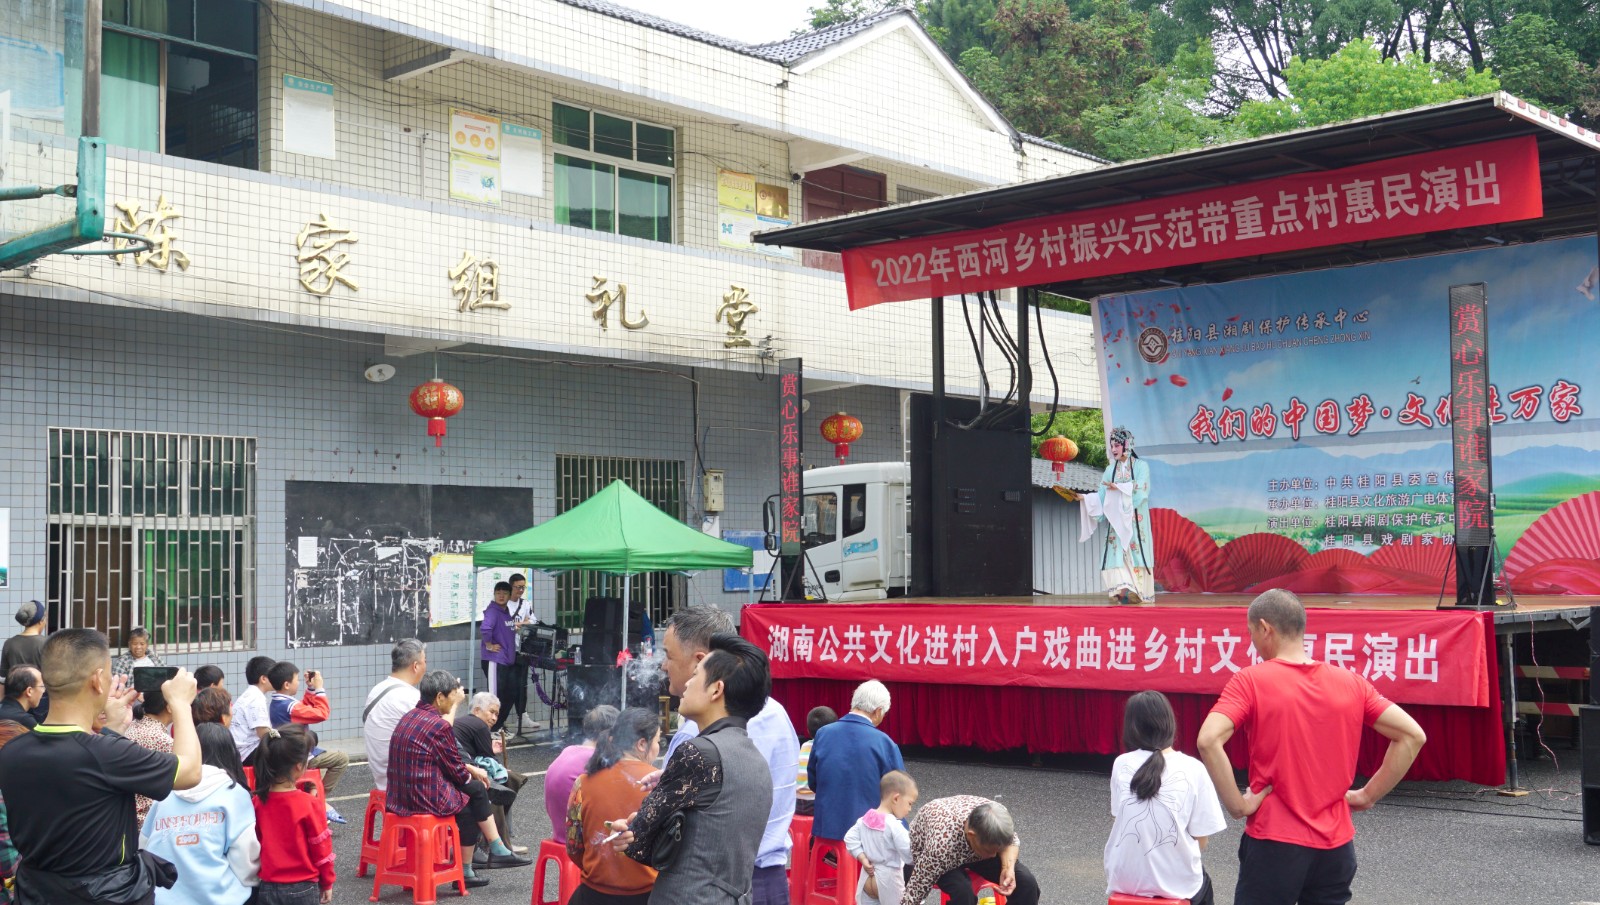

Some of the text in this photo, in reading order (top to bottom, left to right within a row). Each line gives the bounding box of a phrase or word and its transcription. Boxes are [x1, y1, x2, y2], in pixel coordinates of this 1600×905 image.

[872, 160, 1501, 287] 2022年西河乡村振兴示范带重点村惠民演出
[1170, 308, 1369, 344] 桂阳县湘剧保护传承中心
[1330, 332, 1357, 345] ZHONG
[781, 373, 800, 543] 赏心乐事谁家院
[1453, 303, 1488, 530] 赏心乐事谁家院
